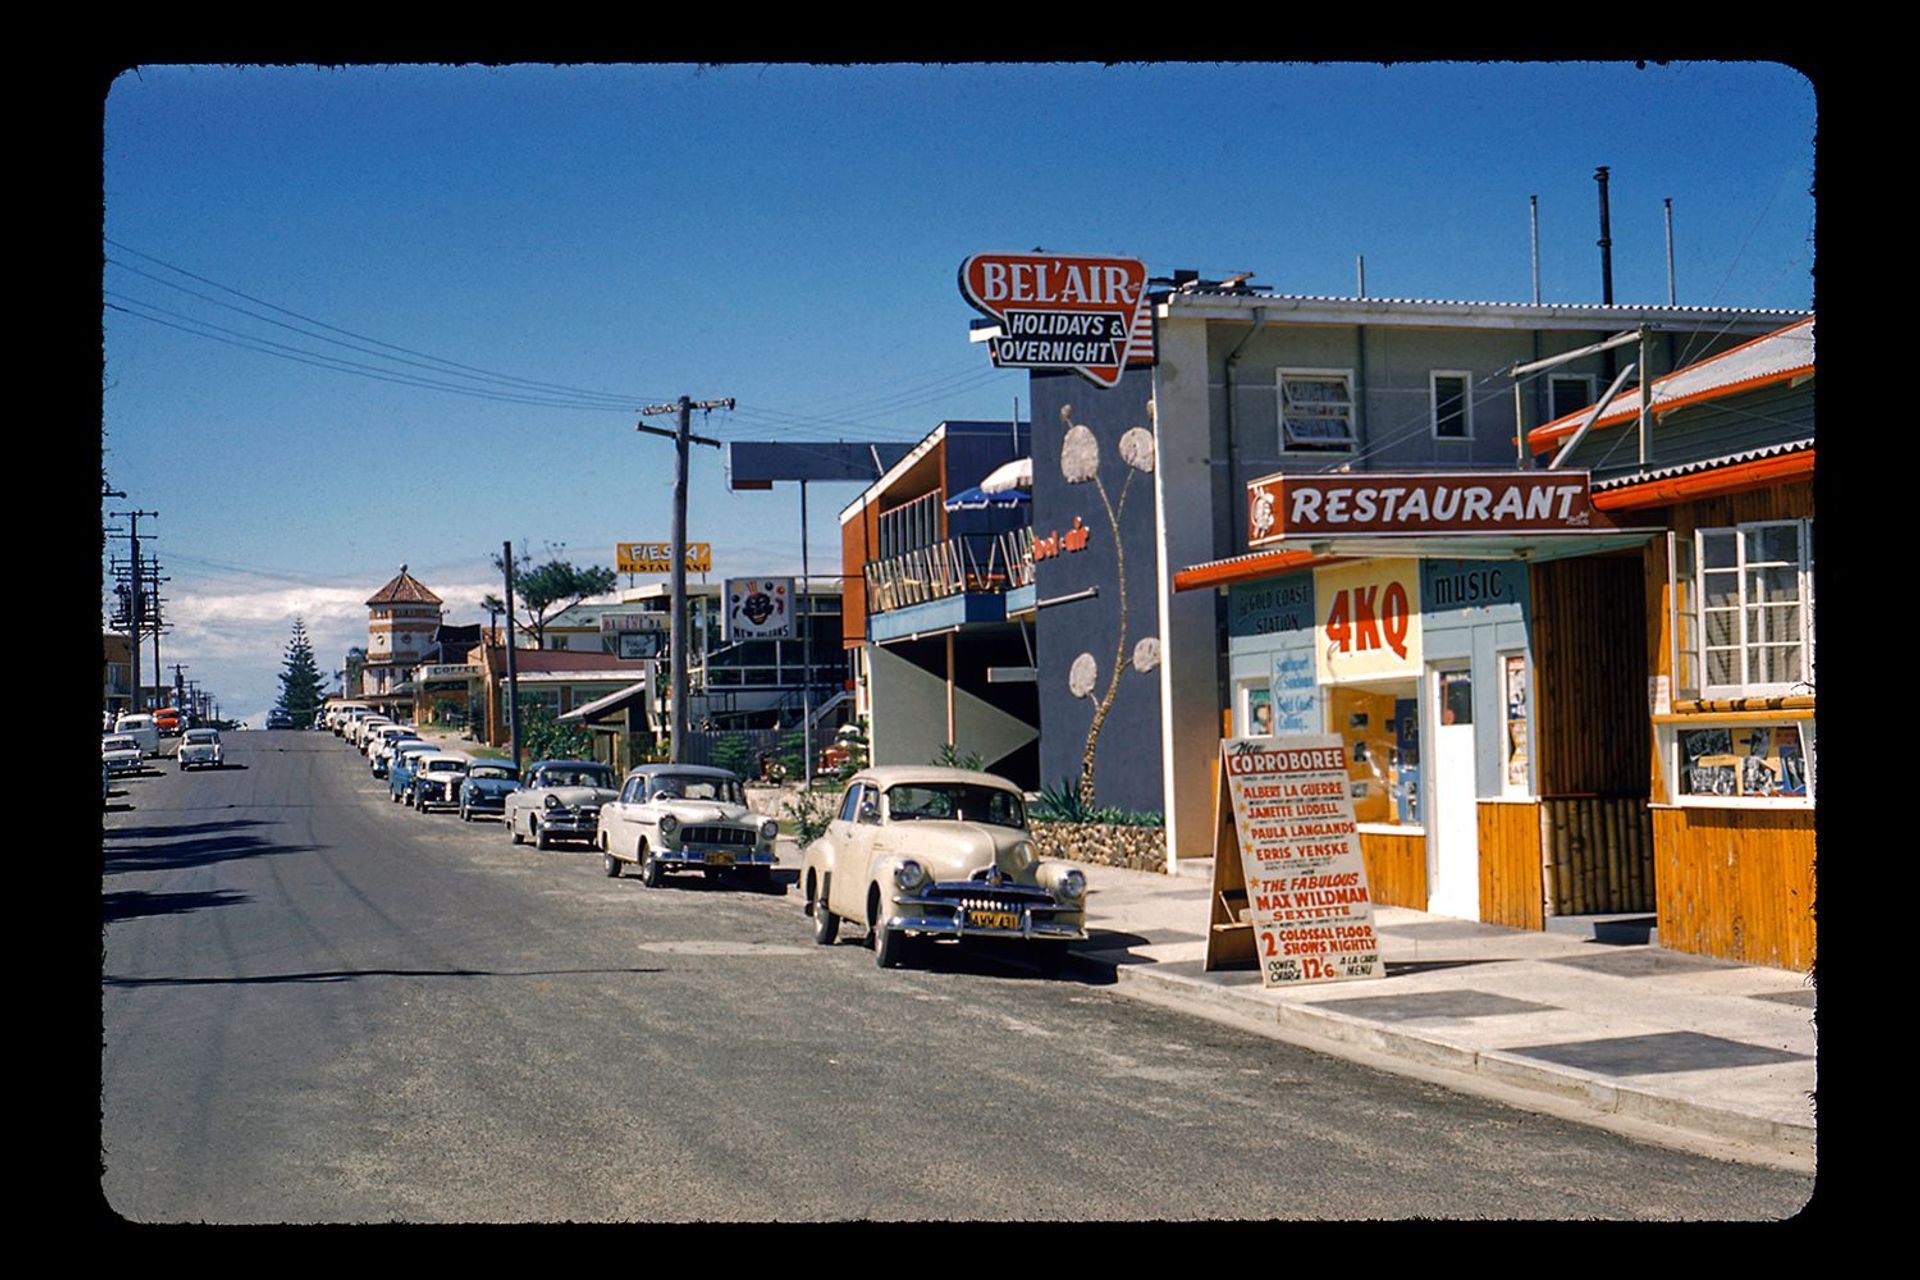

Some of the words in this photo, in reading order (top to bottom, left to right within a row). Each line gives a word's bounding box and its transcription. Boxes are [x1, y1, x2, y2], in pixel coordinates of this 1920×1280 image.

[982, 261, 1137, 304] BEL'AIR
[1012, 314, 1103, 336] HOLIDAYS
[1110, 320, 1123, 336] &
[1001, 340, 1110, 363] OVERNIGHT
[1291, 485, 1582, 523] RESTAURANT
[630, 545, 699, 561] FIESA
[1250, 591, 1273, 610] GOLD
[1275, 585, 1308, 607] COAST
[1256, 613, 1301, 635] STATION
[1325, 581, 1409, 661] 4KQ
[733, 626, 753, 638] NEW
[433, 665, 479, 675] COFFEE
[1231, 750, 1344, 773] CORROBOREE
[1243, 785, 1281, 799] ALBERT
[1284, 784, 1299, 797] LA
[1300, 782, 1343, 796] GUERRE
[1248, 805, 1293, 819] JANETTE
[1296, 802, 1339, 816] LIDDELL
[1251, 826, 1288, 840] PAULA
[1290, 822, 1356, 837] LANGLANDS
[1256, 847, 1291, 861] ERRIS
[1296, 842, 1349, 857] VENSKE
[1262, 878, 1287, 893] THE
[1291, 872, 1359, 890] FABULOUS
[1256, 894, 1292, 911] MAX
[1294, 887, 1368, 908] WILDMAN
[1273, 906, 1351, 921] SEXTETTE
[1279, 927, 1335, 941] COLOSSAL
[1336, 926, 1372, 939] FLOOR
[1261, 931, 1278, 957] 2
[1284, 941, 1327, 956] SHOWS
[1330, 938, 1377, 952] NIGHTLY
[1346, 964, 1372, 976] MENU
